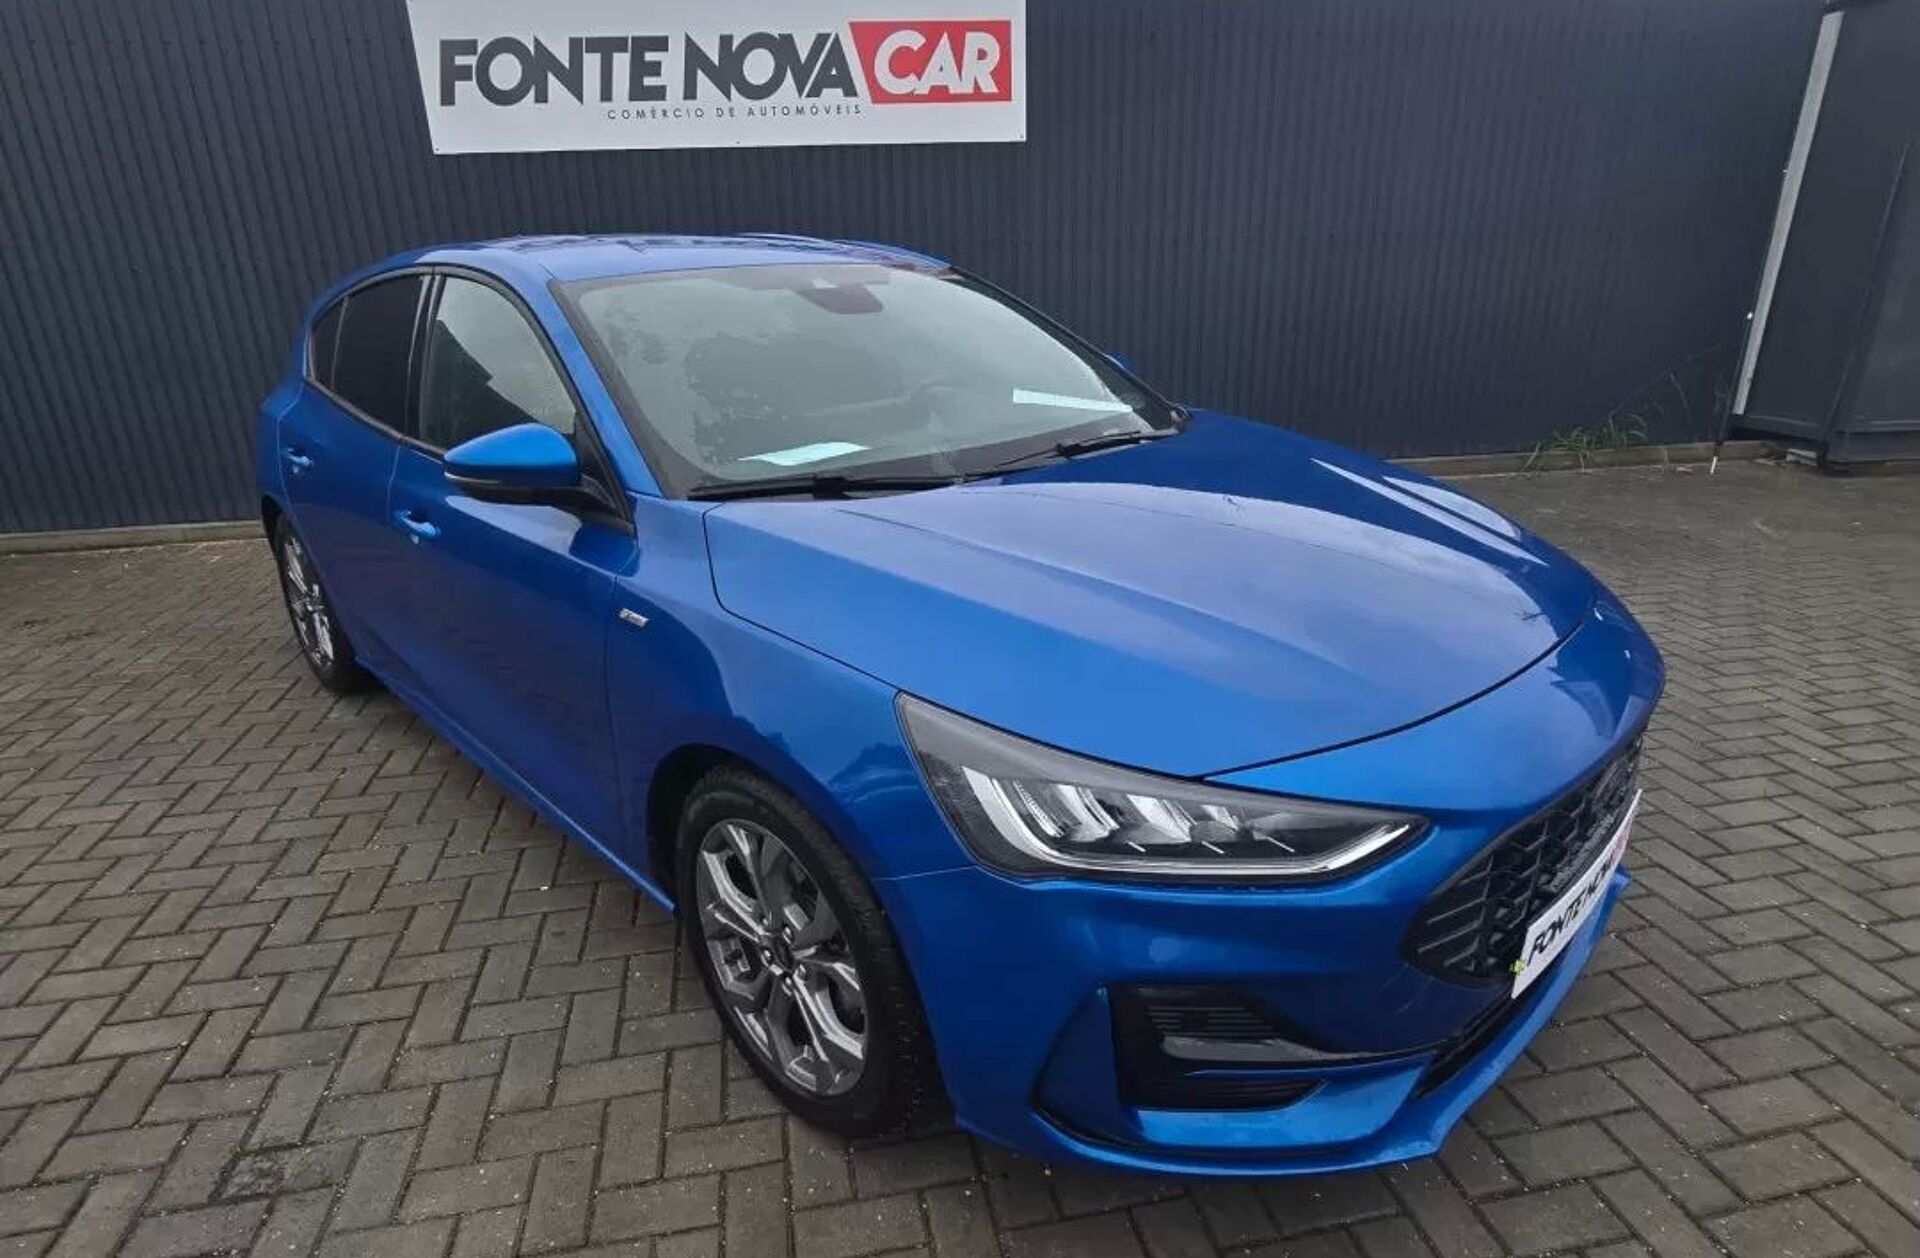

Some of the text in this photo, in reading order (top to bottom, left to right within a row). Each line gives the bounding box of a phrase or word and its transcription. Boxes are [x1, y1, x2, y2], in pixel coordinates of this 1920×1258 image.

[439, 29, 1002, 106] FONTE NOVA CAR
[607, 103, 861, 119] COMÉRCIO DE AUTOMÓVEIS
